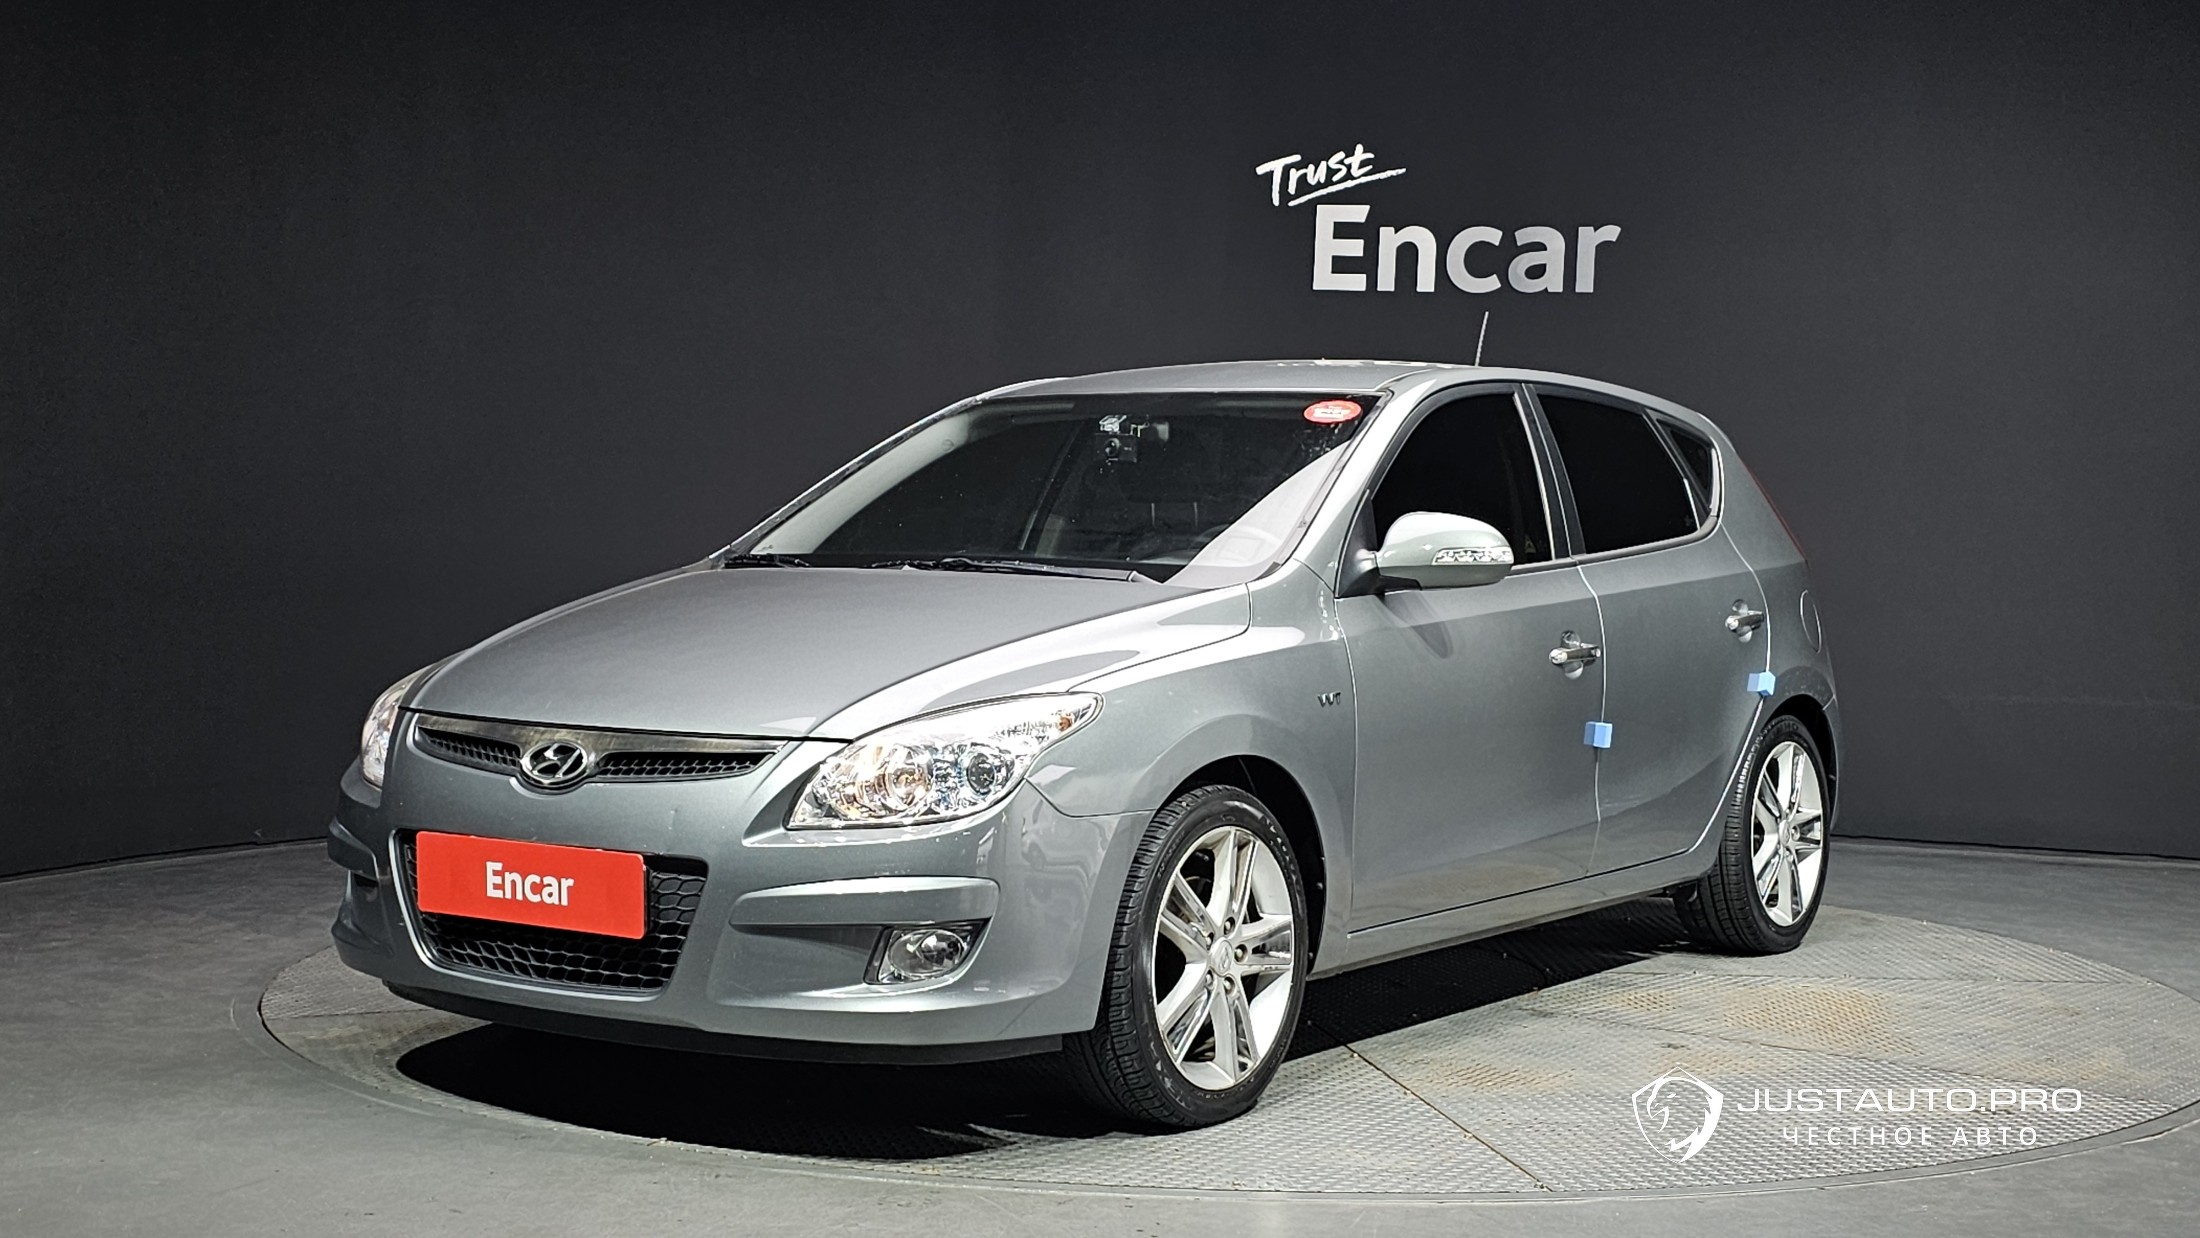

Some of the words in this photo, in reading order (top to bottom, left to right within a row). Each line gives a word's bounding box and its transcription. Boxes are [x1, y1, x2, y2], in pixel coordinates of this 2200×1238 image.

[1256, 144, 1376, 207] Trust
[1312, 204, 1622, 294] Encar
[485, 861, 575, 907] Encar
